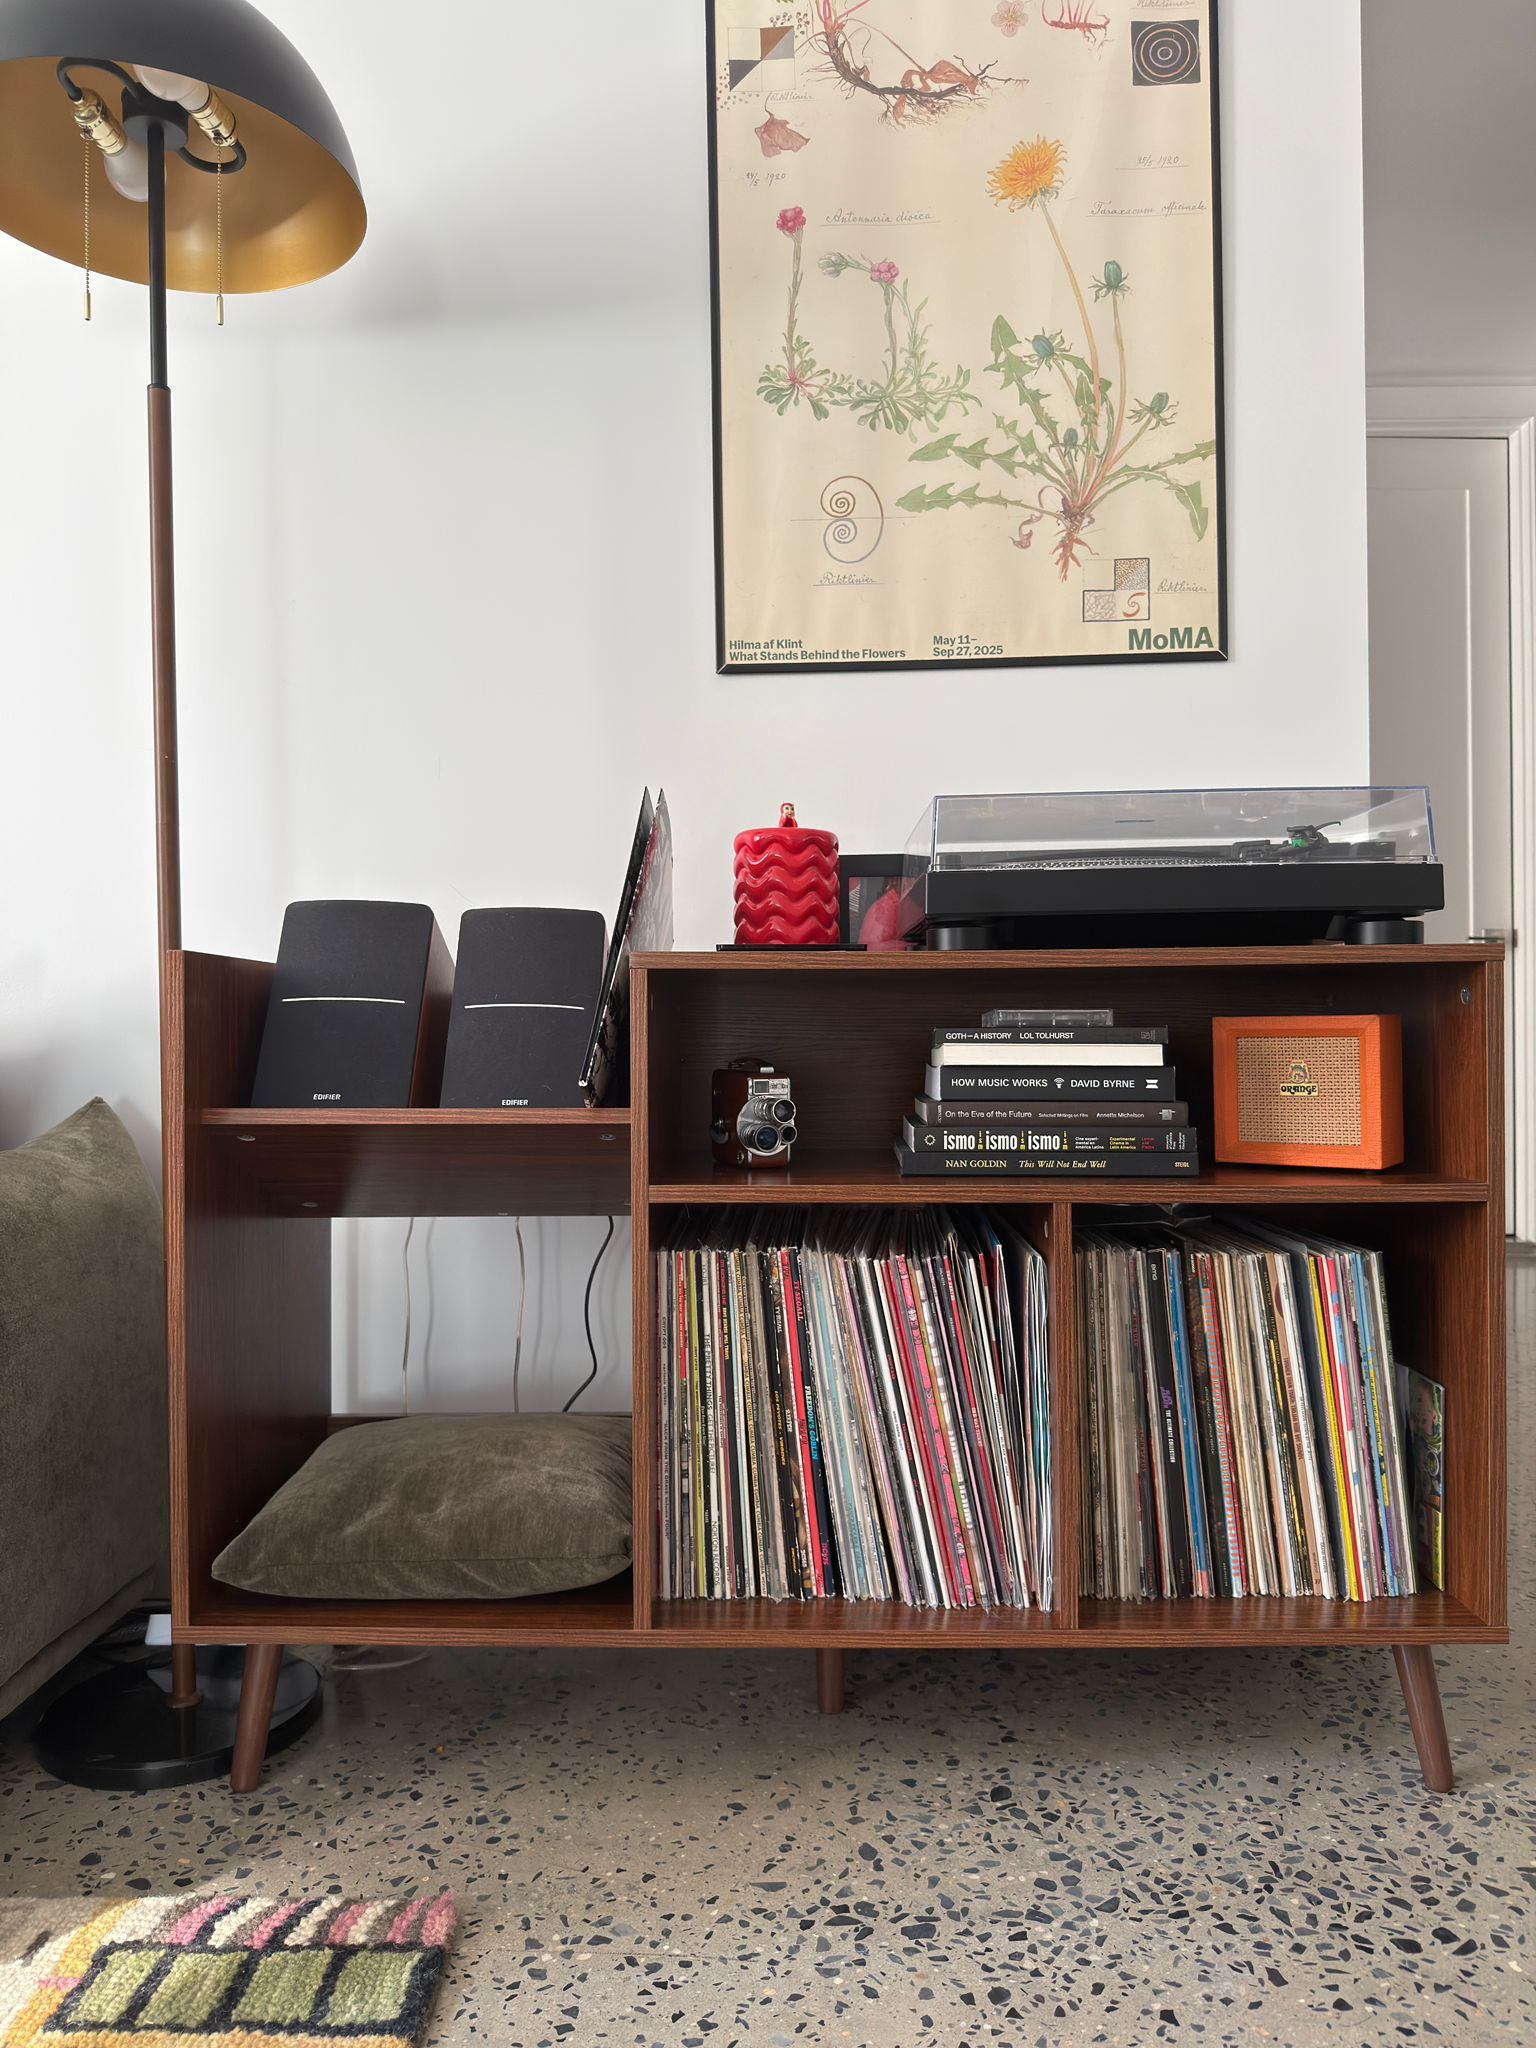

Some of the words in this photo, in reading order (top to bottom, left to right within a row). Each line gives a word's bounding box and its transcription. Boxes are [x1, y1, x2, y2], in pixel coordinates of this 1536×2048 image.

[729, 640, 761, 650] Hilma
[763, 640, 774, 649] af
[777, 639, 803, 649] Klint
[933, 636, 956, 646] May
[1128, 627, 1214, 650] MoMA
[730, 652, 758, 661] What
[760, 651, 798, 660] Stands
[801, 650, 839, 660] Behind
[841, 650, 859, 659] the
[862, 649, 906, 658] Flowers
[933, 647, 954, 658] Sep
[956, 646, 972, 656] 27,
[974, 645, 1003, 655] 2025
[951, 1079, 976, 1087] HOW
[978, 1079, 1010, 1088] MUSIC
[1012, 1079, 1048, 1088] WORKS
[1070, 1080, 1100, 1088] DAVID
[1103, 1080, 1135, 1088] BYRNE
[1280, 1085, 1318, 1094] ORANGE
[944, 1131, 975, 1150] ismo
[986, 1131, 1017, 1150] ismo
[1028, 1131, 1060, 1150] ismo
[946, 1160, 967, 1168] NAN
[970, 1160, 1007, 1168] GOLDIN
[1019, 1160, 1035, 1168] This
[1037, 1160, 1054, 1168] Will
[1056, 1160, 1070, 1168] Not
[1072, 1160, 1087, 1168] End
[1089, 1160, 1107, 1168] Well
[794, 1281, 799, 1290] TY
[775, 1306, 781, 1314] TY
[795, 1292, 803, 1321] SEGALL
[804, 1386, 815, 1428] FREEDOM'S
[1284, 1357, 1292, 1374] TOUGHER
[1290, 1405, 1298, 1422] TROJAN
[1296, 1443, 1304, 1460] SOUNDS
[809, 1430, 819, 1460] GOBLIN
